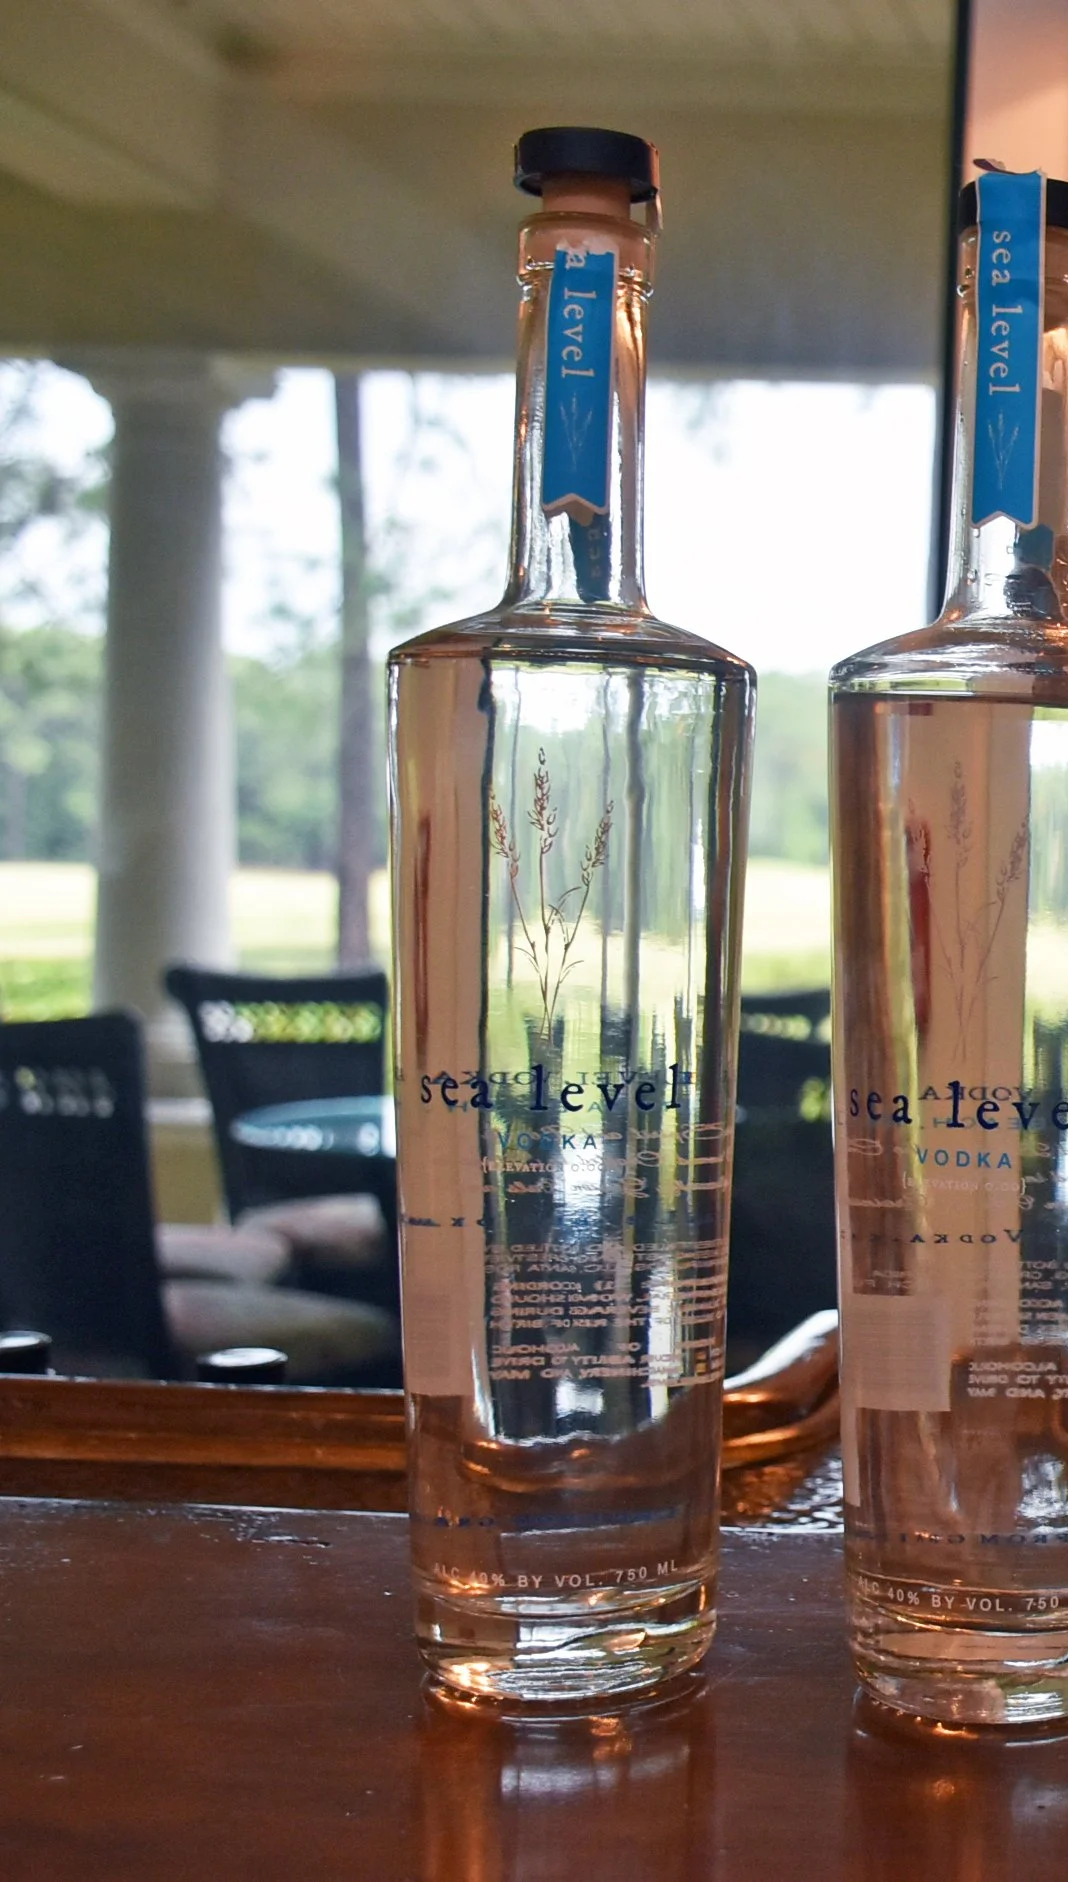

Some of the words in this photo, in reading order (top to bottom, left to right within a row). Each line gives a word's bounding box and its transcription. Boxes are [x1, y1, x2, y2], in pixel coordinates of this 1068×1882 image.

[991, 230, 1012, 287] sea
[561, 287, 597, 379] level
[988, 304, 1024, 396] level
[420, 1074, 494, 1110] sea
[529, 1063, 682, 1112] level
[840, 1088, 913, 1125] sea
[499, 1130, 598, 1151] VODKA
[915, 1147, 1013, 1170] VODKA
[516, 1574, 543, 1589] BY
[553, 1573, 604, 1588] VOL.
[614, 1565, 648, 1584] 750
[656, 1558, 679, 1577] ML
[886, 1586, 921, 1607] 40%
[930, 1593, 956, 1610] BY
[965, 1597, 1014, 1613] VOL.
